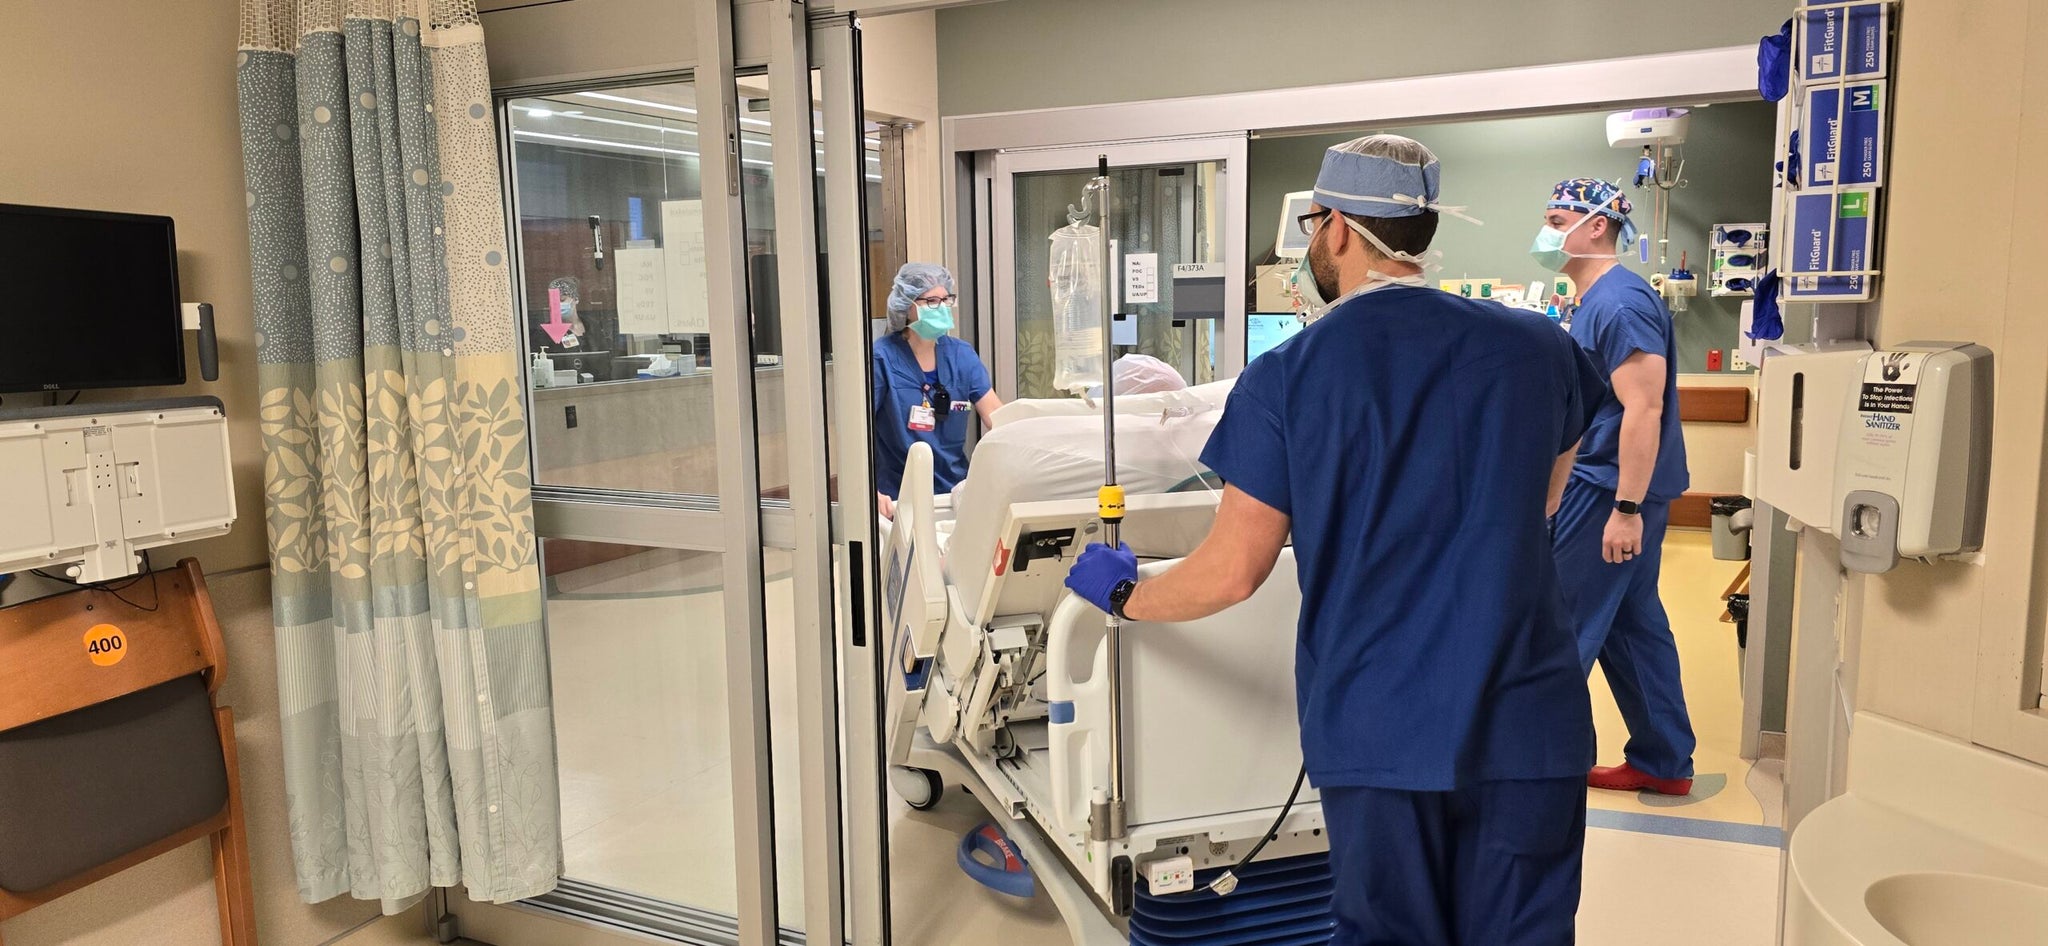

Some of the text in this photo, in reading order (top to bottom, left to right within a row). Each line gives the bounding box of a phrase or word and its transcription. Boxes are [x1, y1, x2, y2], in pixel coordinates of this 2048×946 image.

[1824, 10, 1835, 52] FitGuard
[1866, 51, 1874, 68] 250
[1853, 90, 1870, 106] M
[1862, 161, 1872, 178] 250
[1843, 199, 1860, 209] L
[1809, 231, 1821, 270] FitGuard
[1849, 274, 1858, 290] 250
[1865, 419, 1901, 430] SANITIZER
[1873, 413, 1895, 422] HAND
[89, 635, 122, 654] 400
[995, 838, 1014, 859] BRAKE
